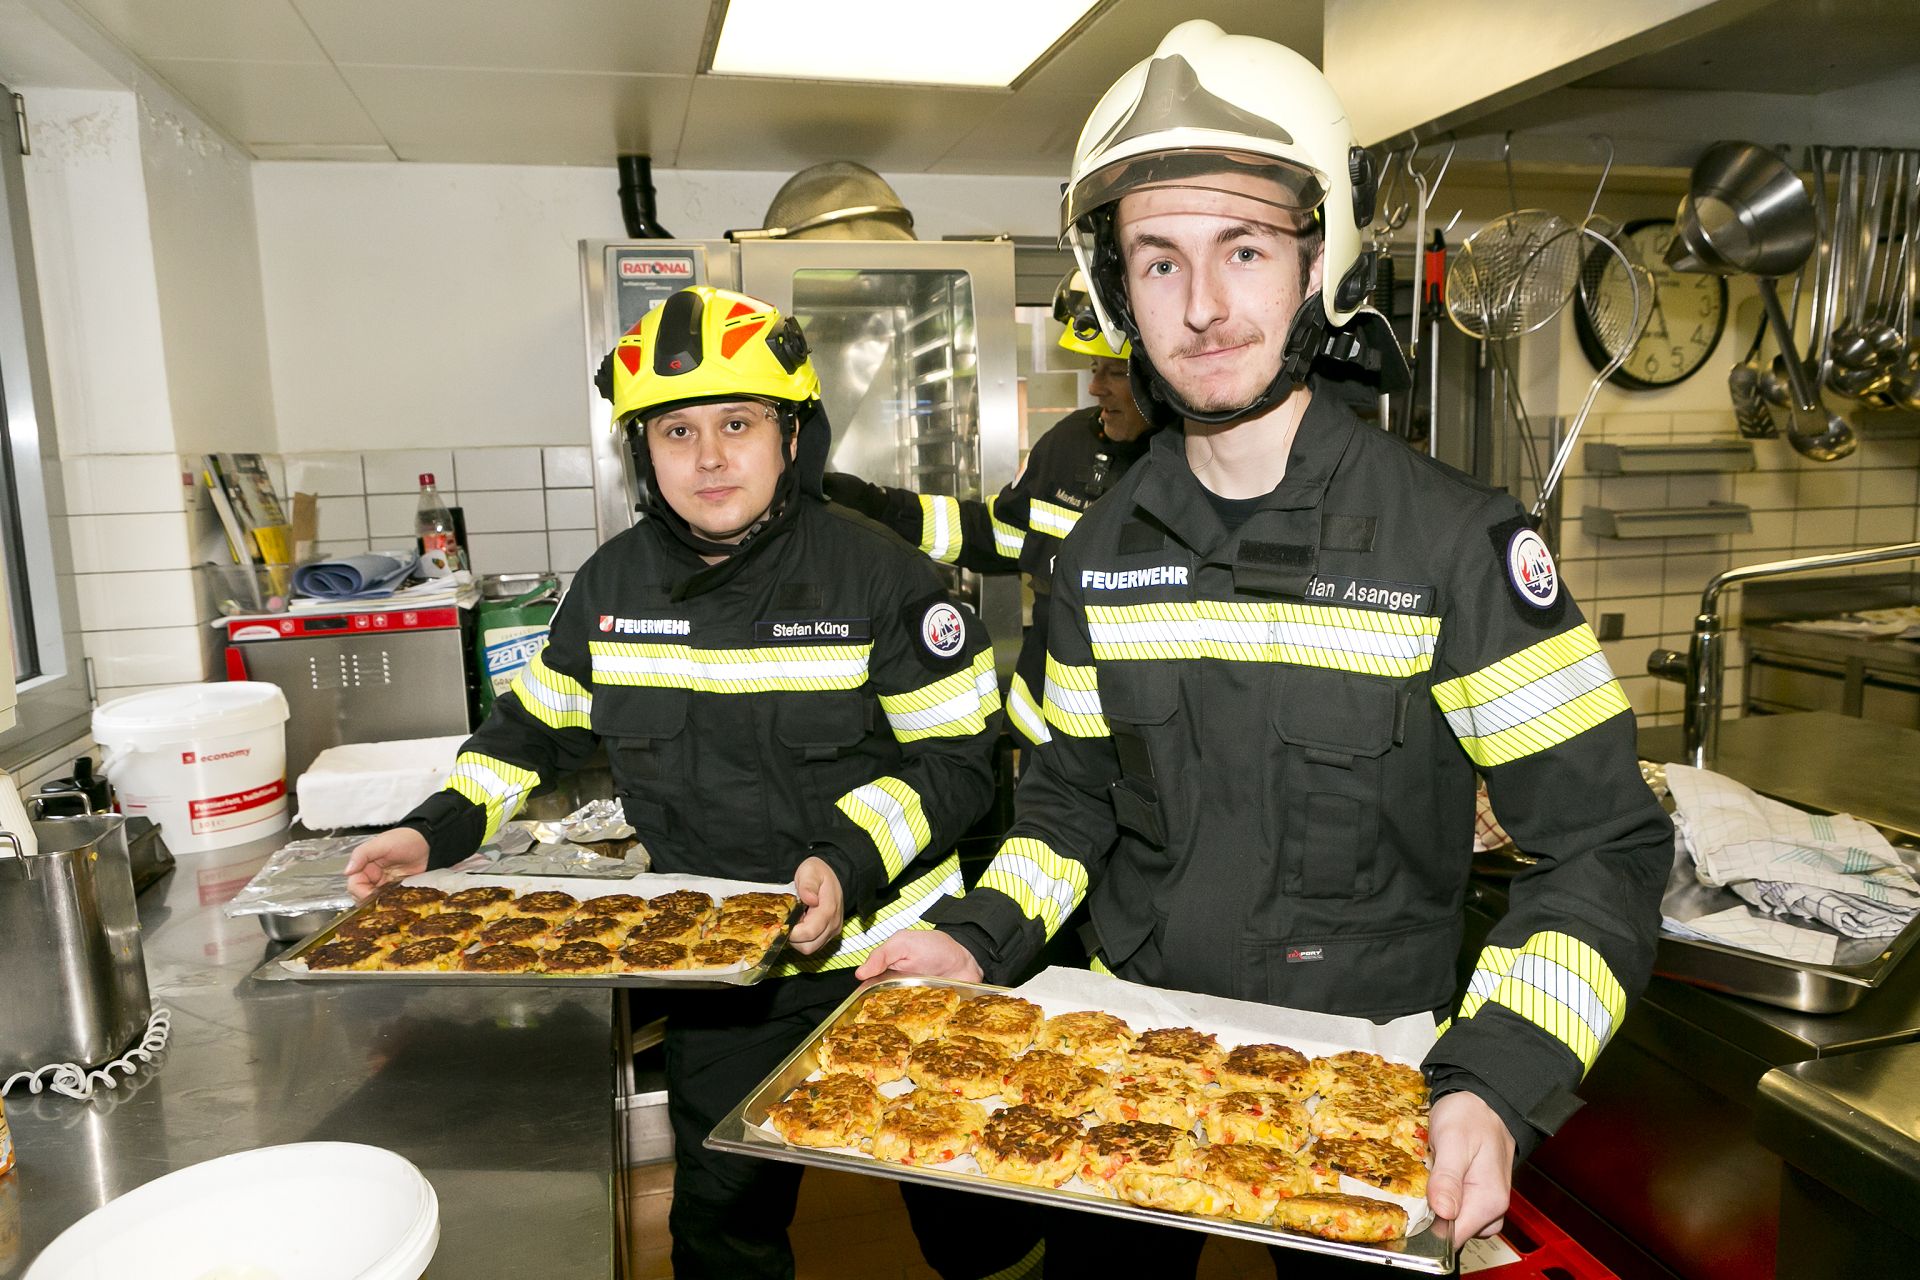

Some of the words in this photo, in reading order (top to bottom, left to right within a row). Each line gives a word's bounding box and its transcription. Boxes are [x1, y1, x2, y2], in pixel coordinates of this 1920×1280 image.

[623, 261, 689, 274] RATIONAL
[1690, 325, 1708, 347] 4
[1645, 352, 1659, 375] 6
[1671, 346, 1684, 369] 5
[1081, 566, 1189, 590] FEUERWEHR
[1343, 581, 1422, 611] Asanger
[614, 618, 691, 636] FEUERWEHR
[772, 622, 812, 637] Stefan
[814, 621, 849, 638] Küng
[200, 748, 251, 763] economy
